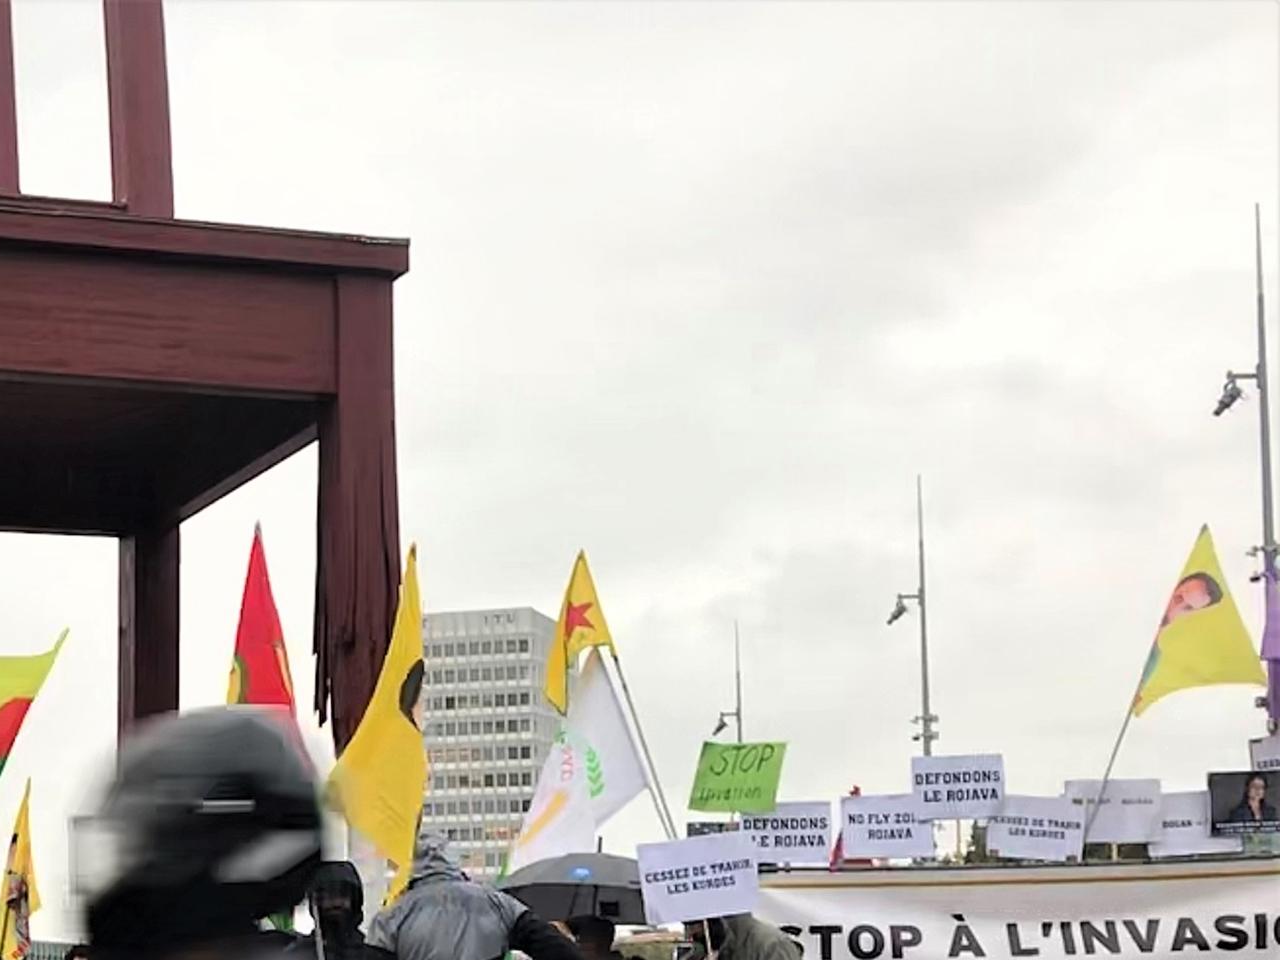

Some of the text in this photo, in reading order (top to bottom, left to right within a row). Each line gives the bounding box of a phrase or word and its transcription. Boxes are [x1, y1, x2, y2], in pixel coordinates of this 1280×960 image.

[709, 743, 776, 777] STOP
[923, 789, 942, 803] LE
[848, 813, 865, 825] NO
[868, 813, 891, 825] FLY
[645, 867, 690, 883] CESSEZ
[692, 865, 707, 877] DE
[666, 882, 690, 895] LES
[947, 913, 987, 959] À
[1006, 912, 1280, 958] L'INVASI
